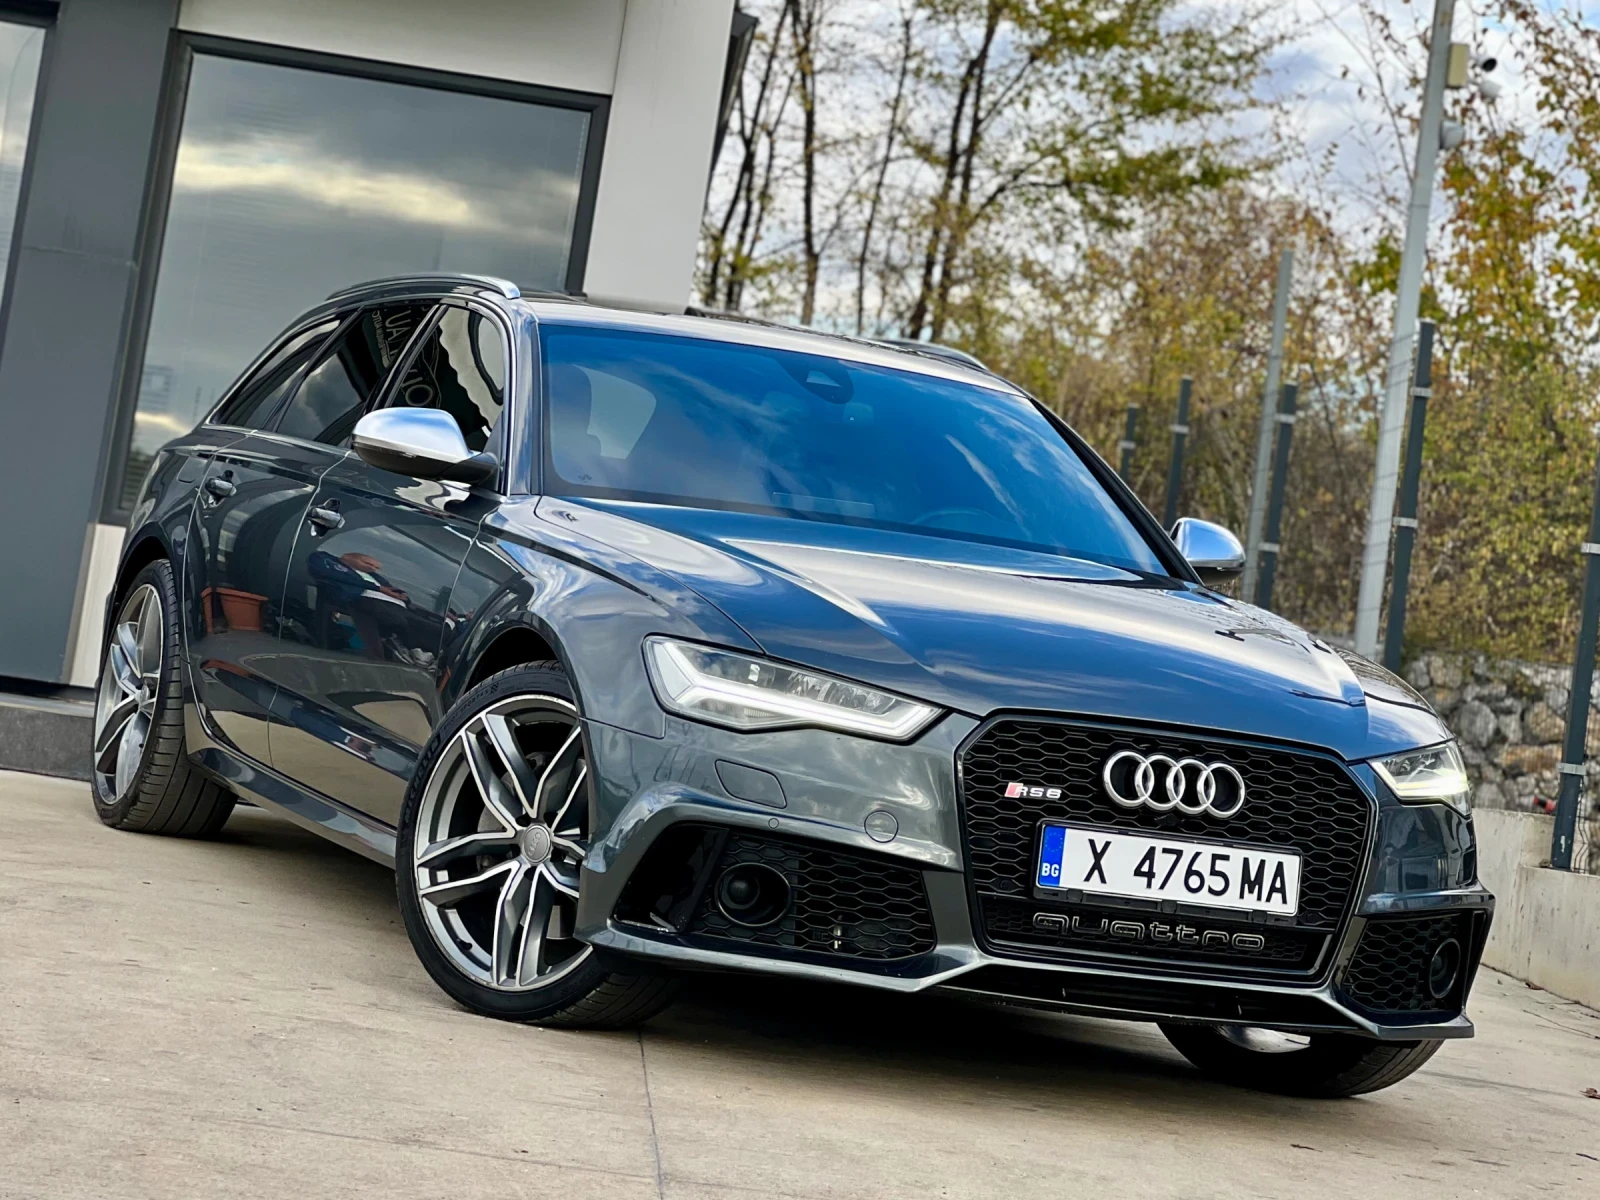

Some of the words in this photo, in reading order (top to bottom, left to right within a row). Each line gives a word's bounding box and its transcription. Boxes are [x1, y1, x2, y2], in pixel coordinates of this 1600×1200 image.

[1009, 784, 1062, 799] RS6
[1041, 862, 1060, 878] BG
[1133, 847, 1230, 897] 4765
[1239, 858, 1289, 905] MA
[1032, 911, 1266, 953] quattro
